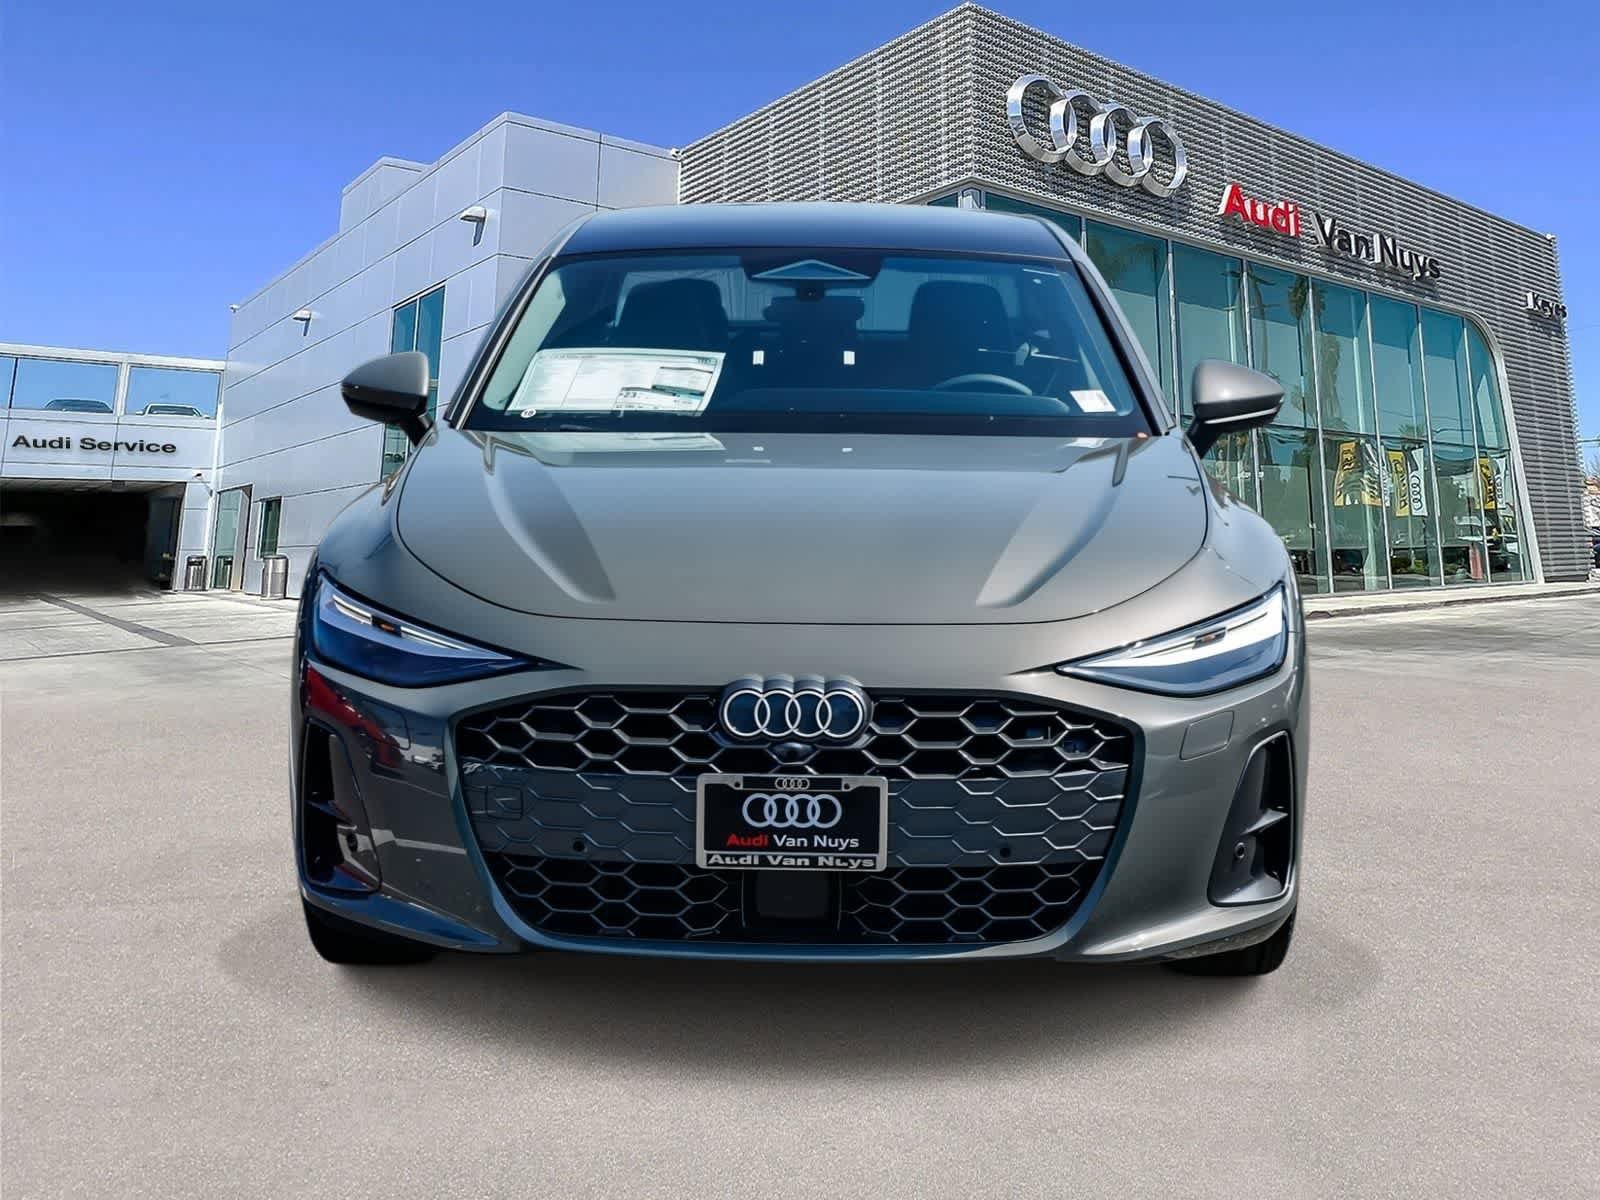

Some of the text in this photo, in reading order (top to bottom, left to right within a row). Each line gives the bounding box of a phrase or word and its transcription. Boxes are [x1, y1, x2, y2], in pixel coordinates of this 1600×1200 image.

[1218, 183, 1441, 280] Audi Van Nuys
[12, 435, 177, 453] Audi Service
[726, 833, 860, 850] Audi Van Nuys
[708, 854, 875, 869] Audi Van Nuys
